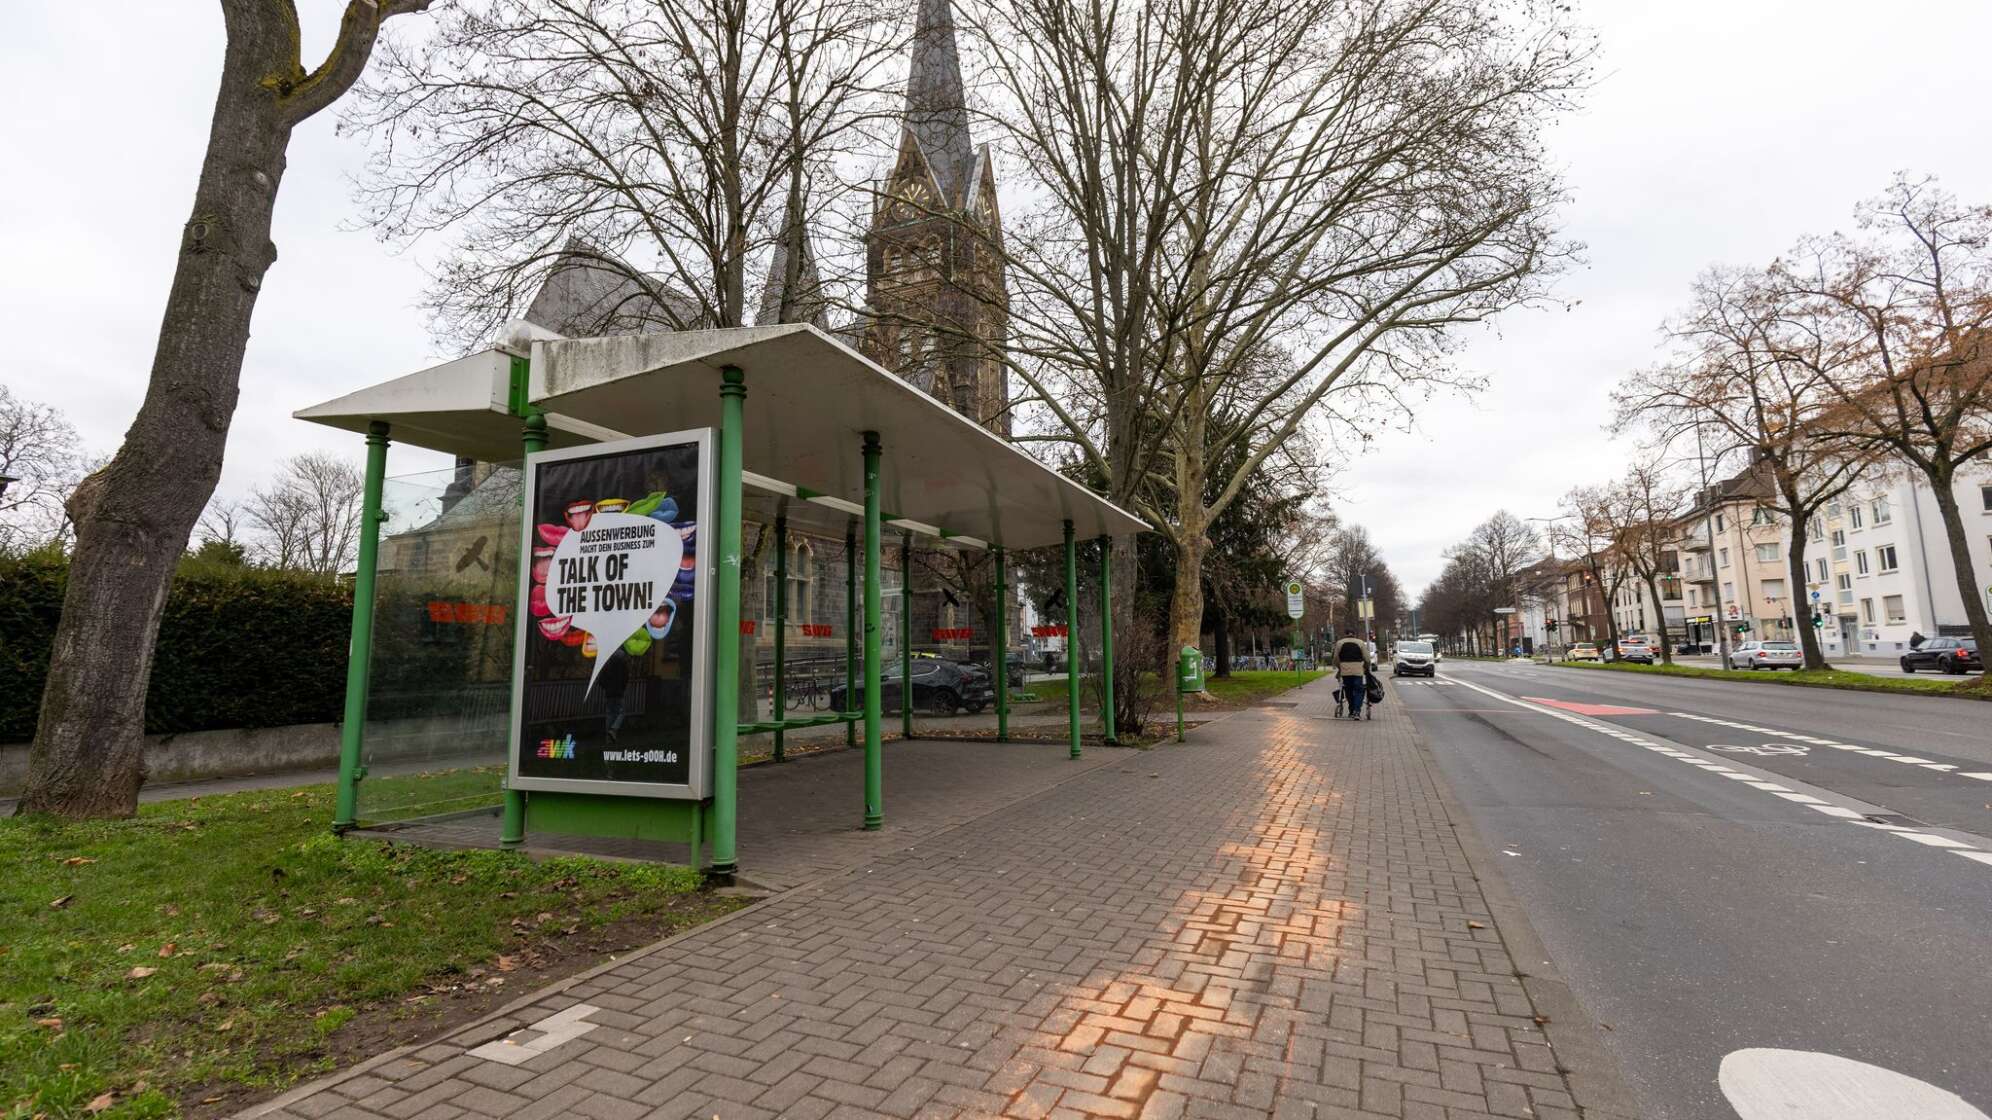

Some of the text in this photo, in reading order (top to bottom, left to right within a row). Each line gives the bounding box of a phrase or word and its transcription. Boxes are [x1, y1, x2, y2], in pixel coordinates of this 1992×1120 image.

[580, 524, 655, 543] AUSSENWERBUNG
[580, 539, 655, 554] MACHT DEIN BUSINESS ZUM
[559, 553, 629, 584] TALK OF
[557, 581, 653, 614] THE TOWN!
